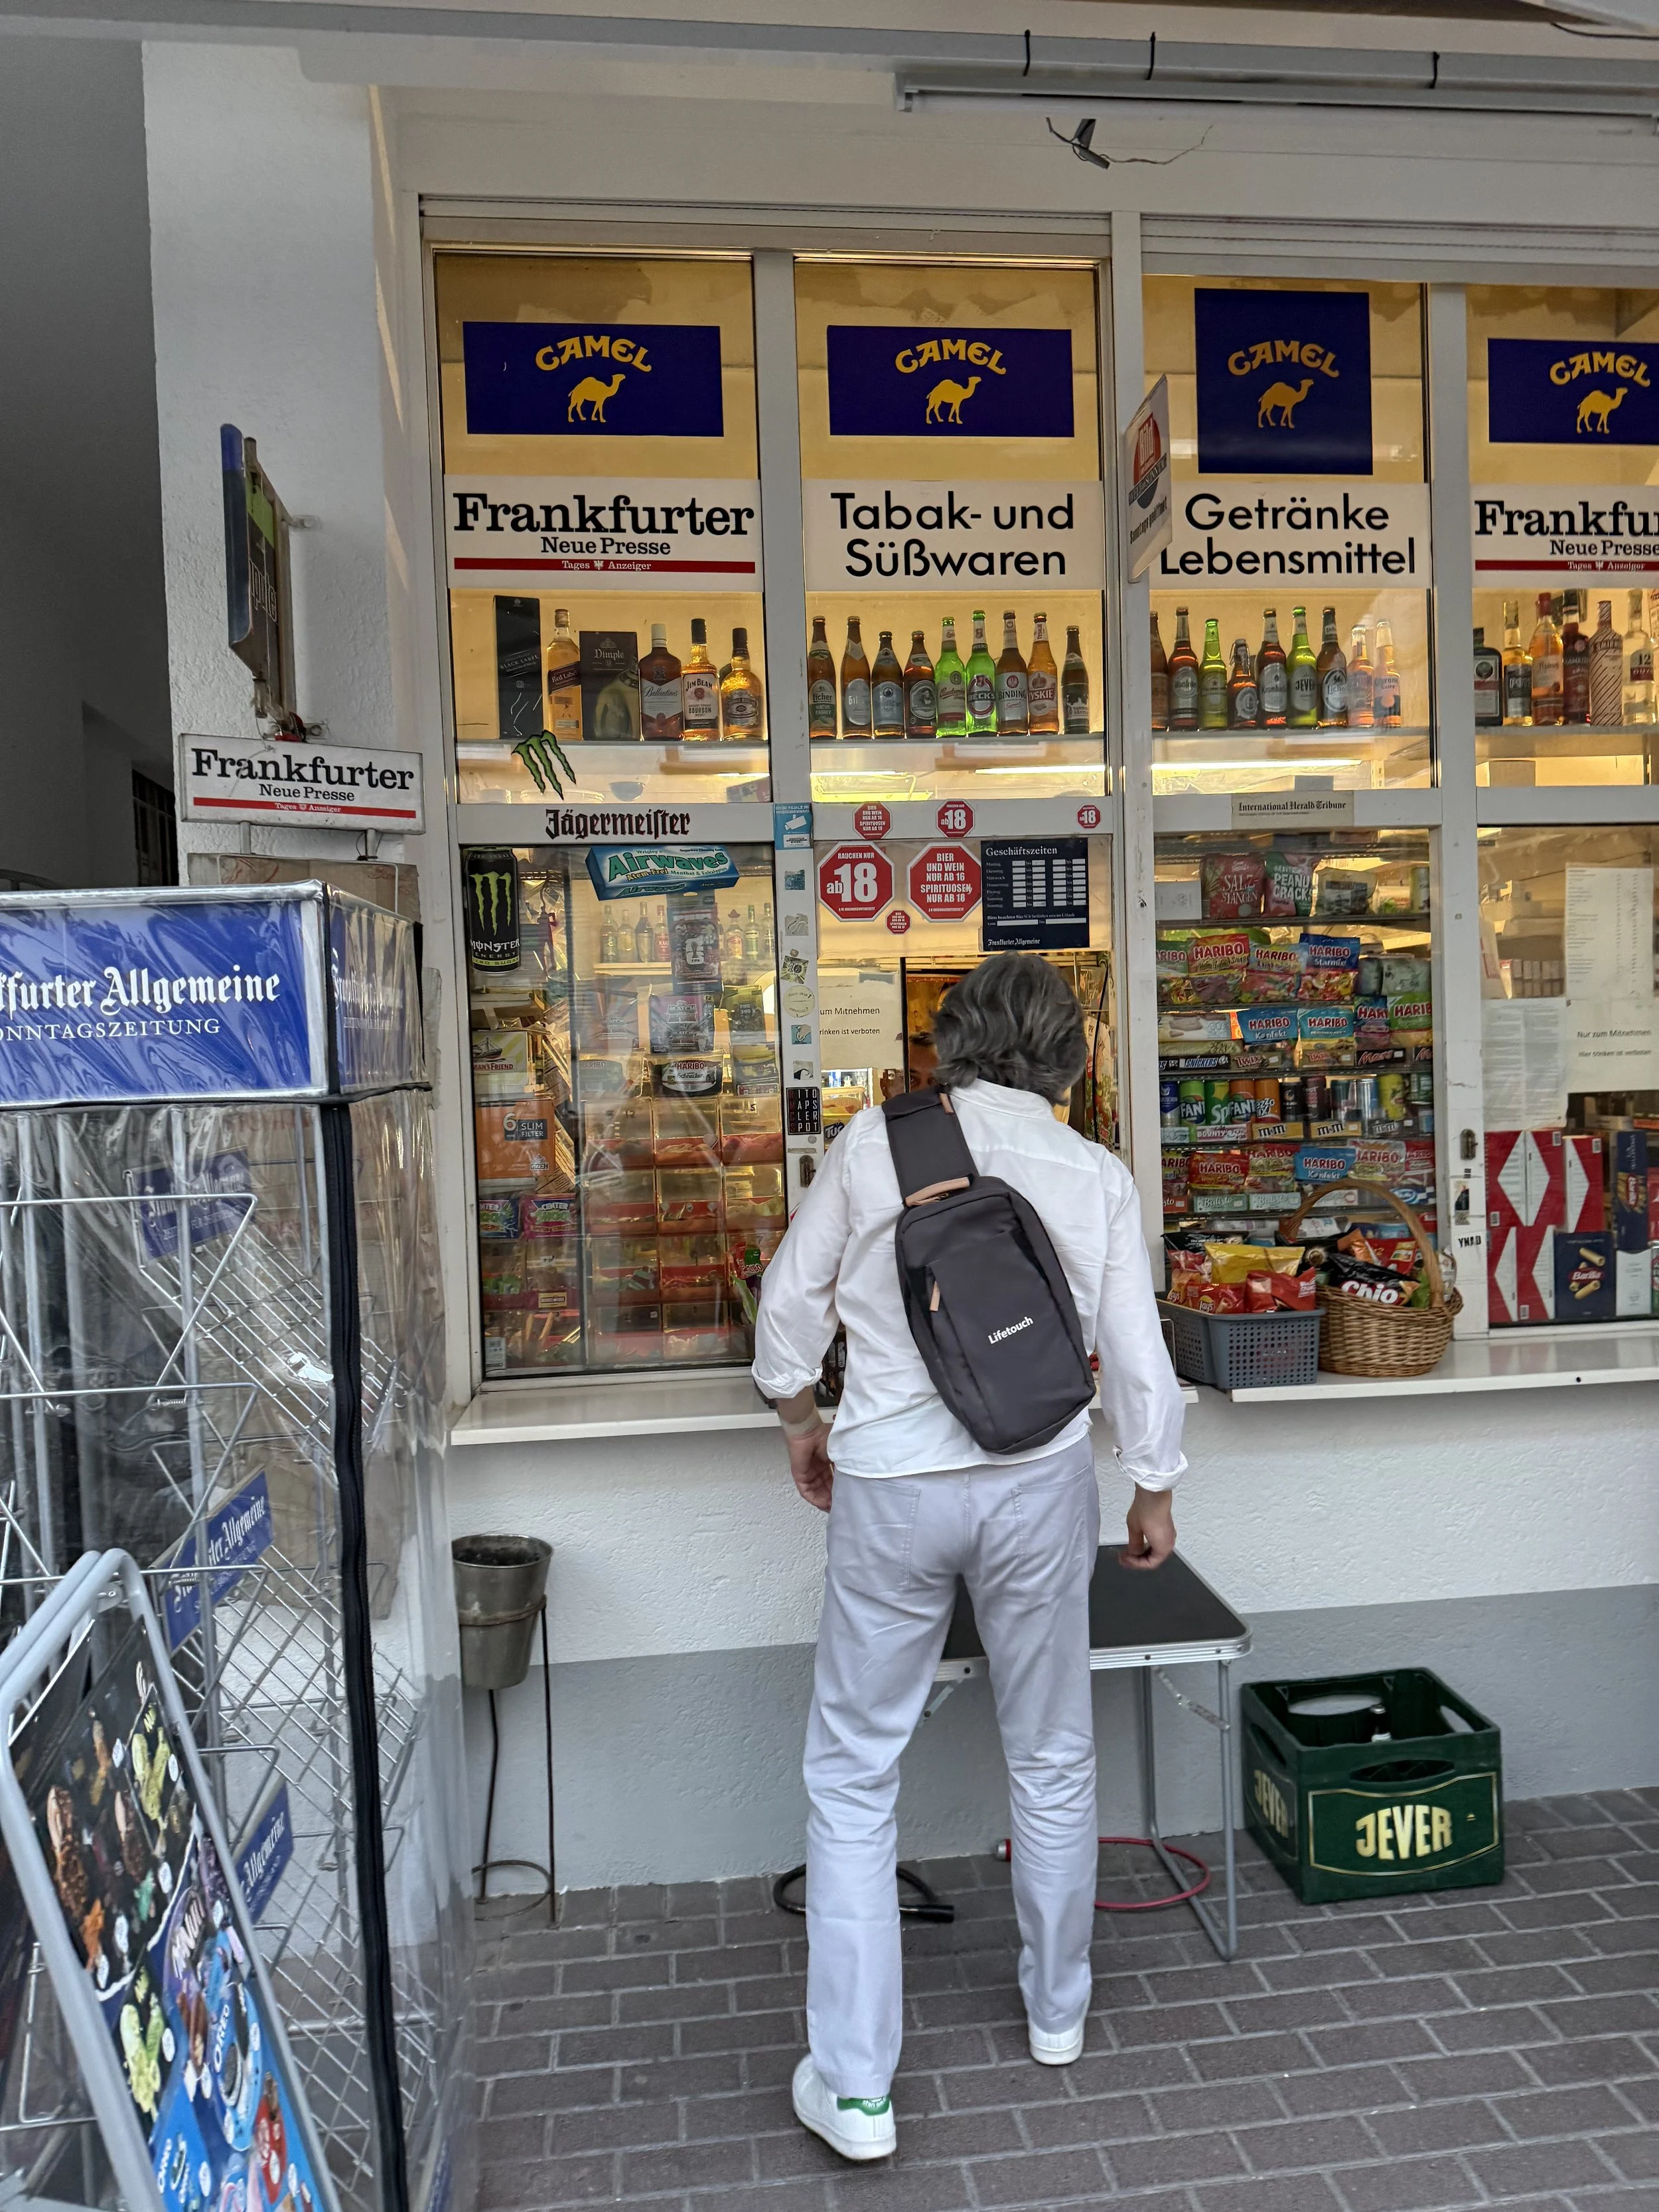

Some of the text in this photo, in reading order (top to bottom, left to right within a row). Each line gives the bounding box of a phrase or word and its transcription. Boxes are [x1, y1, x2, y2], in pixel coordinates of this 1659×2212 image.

[536, 335, 652, 372] CAMEL
[895, 339, 1007, 374] CAMEL
[1228, 340, 1339, 378] CAMEL
[1550, 352, 1650, 387] CAMEL
[453, 492, 755, 535] Frankfurter
[831, 490, 1074, 530] Tabak- und
[1185, 492, 1390, 531] Getränke
[540, 536, 671, 555] Neue Presse
[1550, 540, 1659, 557] Neue Presse
[845, 538, 1066, 577] Süßwaren
[1161, 536, 1415, 575] Lebensmittel
[561, 559, 652, 572] Tages Anzeiger
[595, 648, 624, 661] Dimple
[551, 674, 563, 684] Red
[685, 678, 713, 692] JIM BEAM
[191, 747, 415, 790] Frankfurter
[258, 783, 355, 802] Neue Presse
[1238, 800, 1346, 812] International Herald Tribune
[936, 853, 954, 862] BIER
[985, 846, 1058, 856] Geschäftszeiten
[609, 851, 729, 883] Airwaves
[926, 863, 964, 872] UND WEIN
[826, 862, 878, 903] ab 18
[944, 873, 955, 881] AB
[956, 873, 966, 881] 16
[1273, 873, 1311, 888] PEANU
[920, 884, 972, 893] SPIRITUOSEN
[944, 894, 955, 903] AB
[956, 894, 966, 903] 18
[470, 938, 520, 953] MONSTER
[1193, 941, 1245, 960] HARIBO
[1309, 945, 1351, 958] HARIBO
[1255, 949, 1299, 962] HARIBO
[100, 964, 281, 1017] Allgemeine
[820, 1007, 881, 1015] um Mitnehmen
[1249, 1017, 1291, 1030] HARIBO
[1307, 1017, 1348, 1028] HARIBO
[0, 1019, 220, 1042] NNTAGSZEITUNG
[1255, 1029, 1287, 1039] Konfekt
[676, 1061, 705, 1070] HARIBO
[1185, 1056, 1219, 1069] SNICKERS
[1181, 1100, 1206, 1119] FANT
[503, 1112, 517, 1132] 6
[521, 1122, 543, 1130] SLIM
[1198, 1162, 1242, 1174] HARIBO
[1303, 1157, 1346, 1170] HARIBO
[541, 1202, 569, 1211] CENTER
[1341, 1280, 1399, 1304] Chio
[987, 1316, 1034, 1345] Lifetouch
[1356, 1805, 1453, 1860] JEVER
